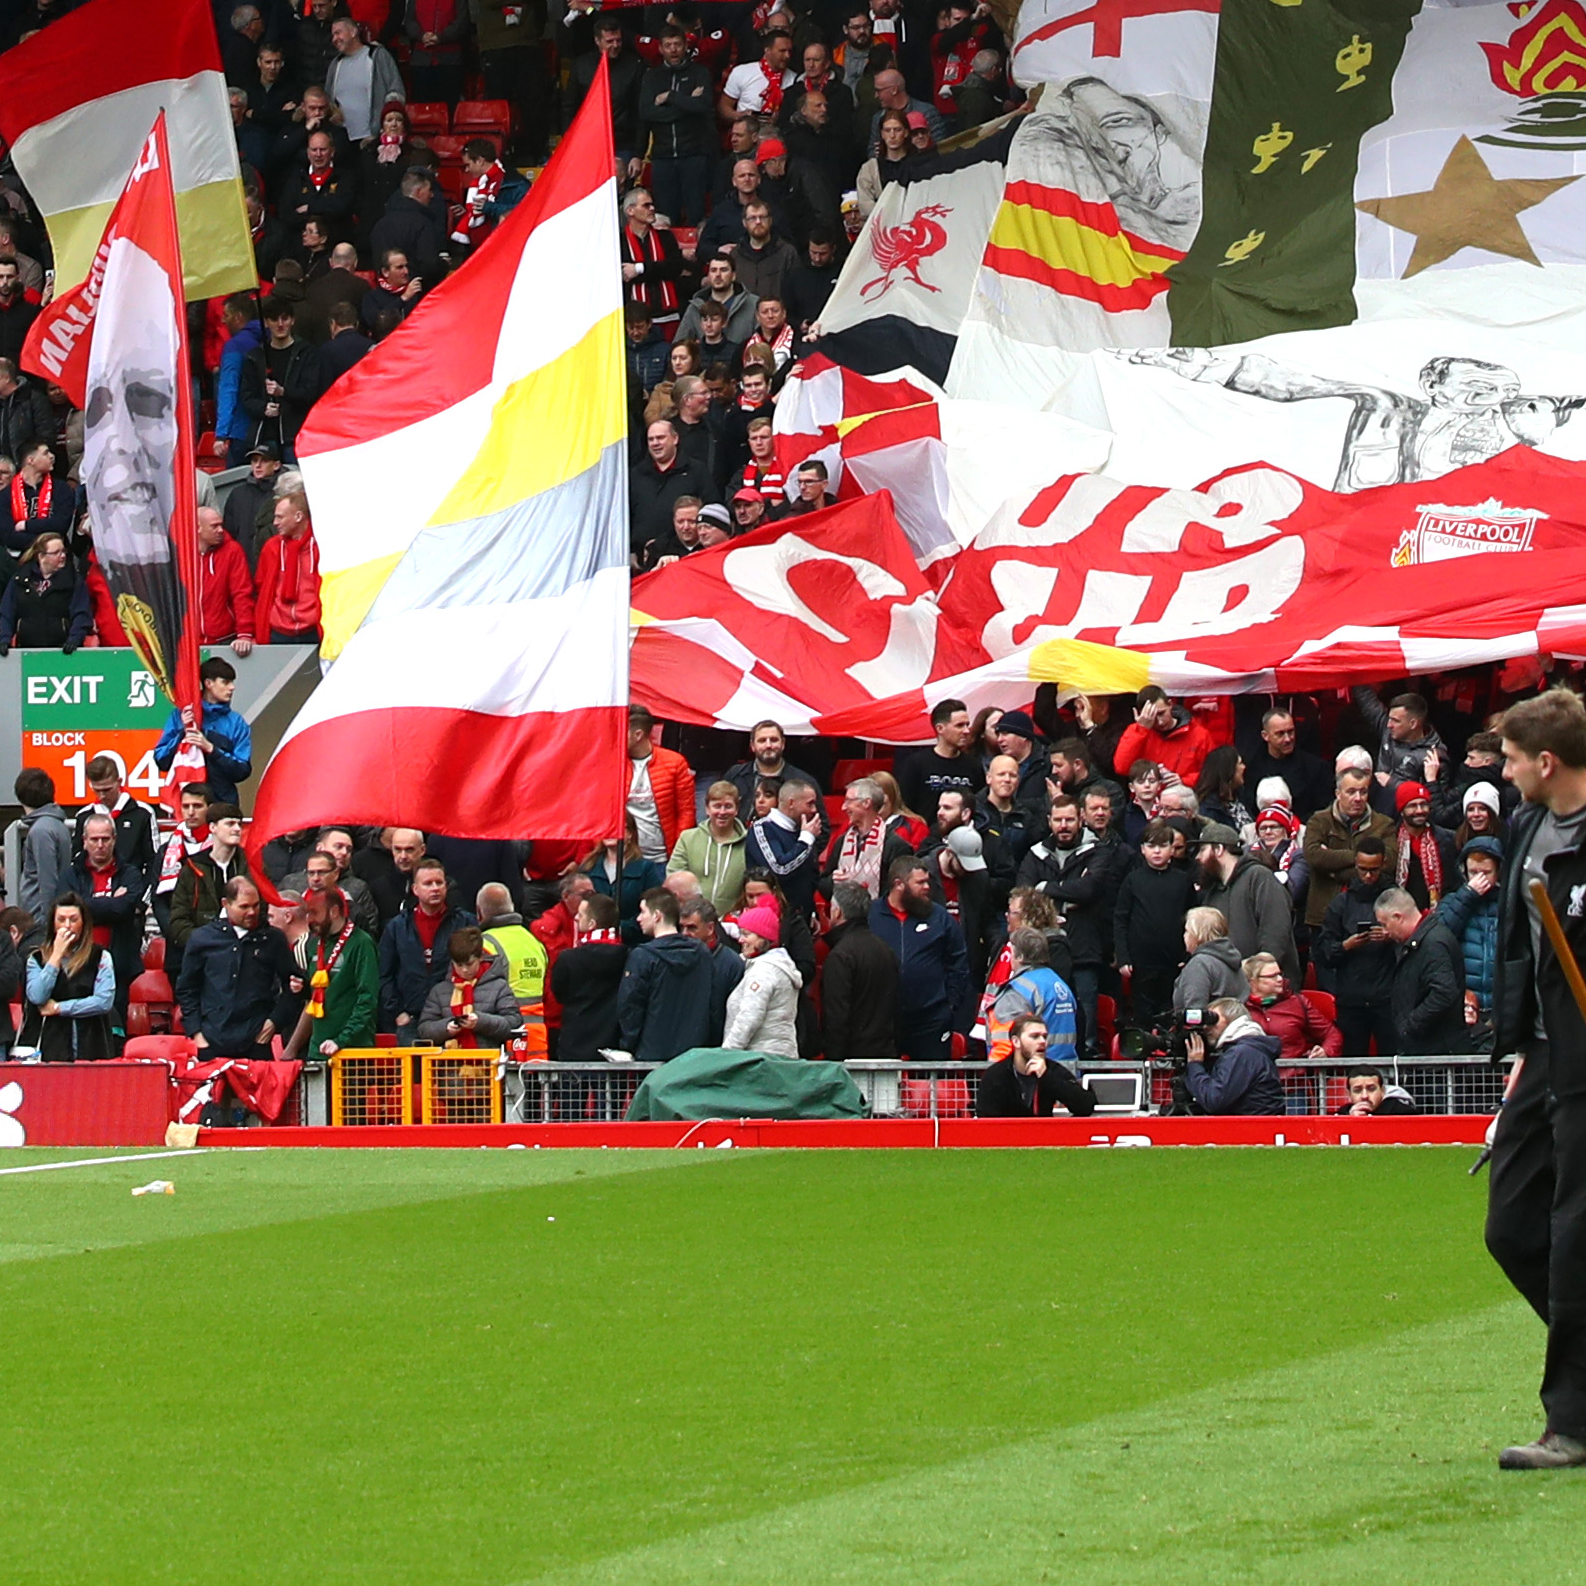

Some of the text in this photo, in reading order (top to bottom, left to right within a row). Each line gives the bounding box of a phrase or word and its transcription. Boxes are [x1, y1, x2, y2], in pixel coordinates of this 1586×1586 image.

[1426, 518, 1522, 544] LIVERPOOL
[1427, 532, 1484, 552] FOOTBALL
[27, 675, 104, 704] EXIT
[32, 732, 86, 746] BLOCK
